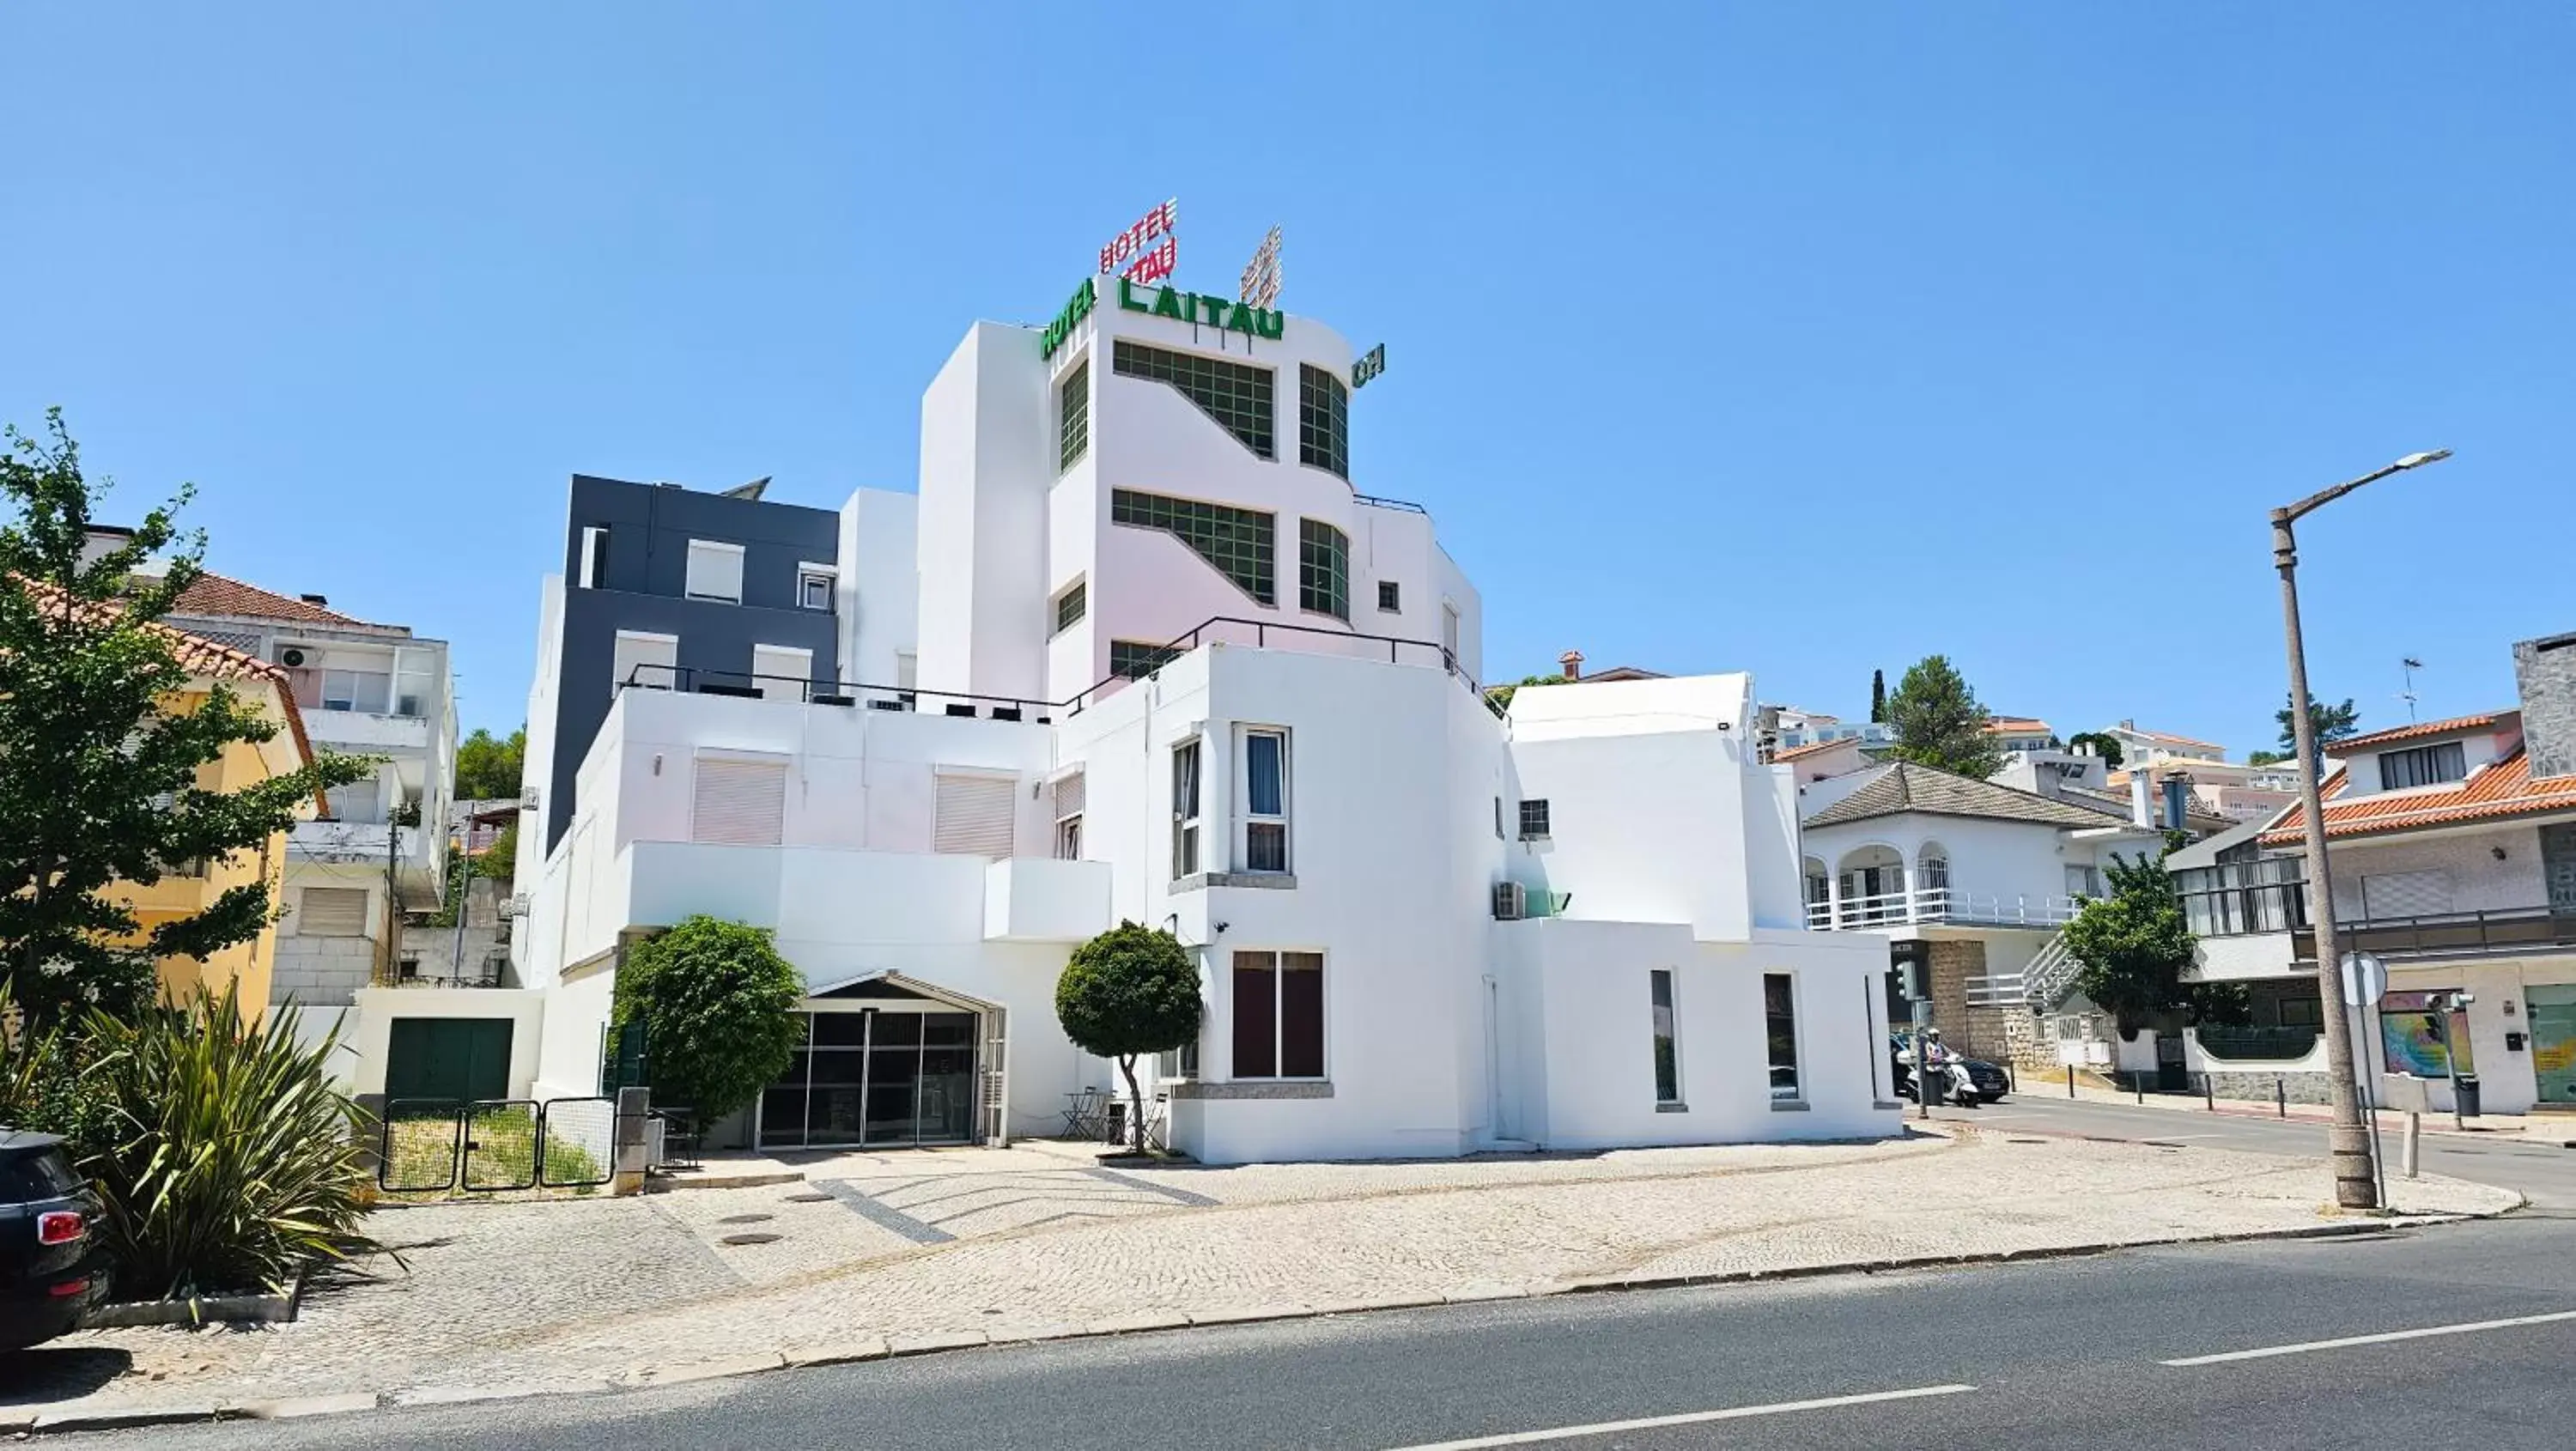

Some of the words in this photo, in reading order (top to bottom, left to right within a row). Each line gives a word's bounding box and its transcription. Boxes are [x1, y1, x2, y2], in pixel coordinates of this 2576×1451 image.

[1100, 200, 1176, 274] HOTEL
[1042, 277, 1097, 361] HOTEL
[1117, 277, 1284, 340] LAITAU
